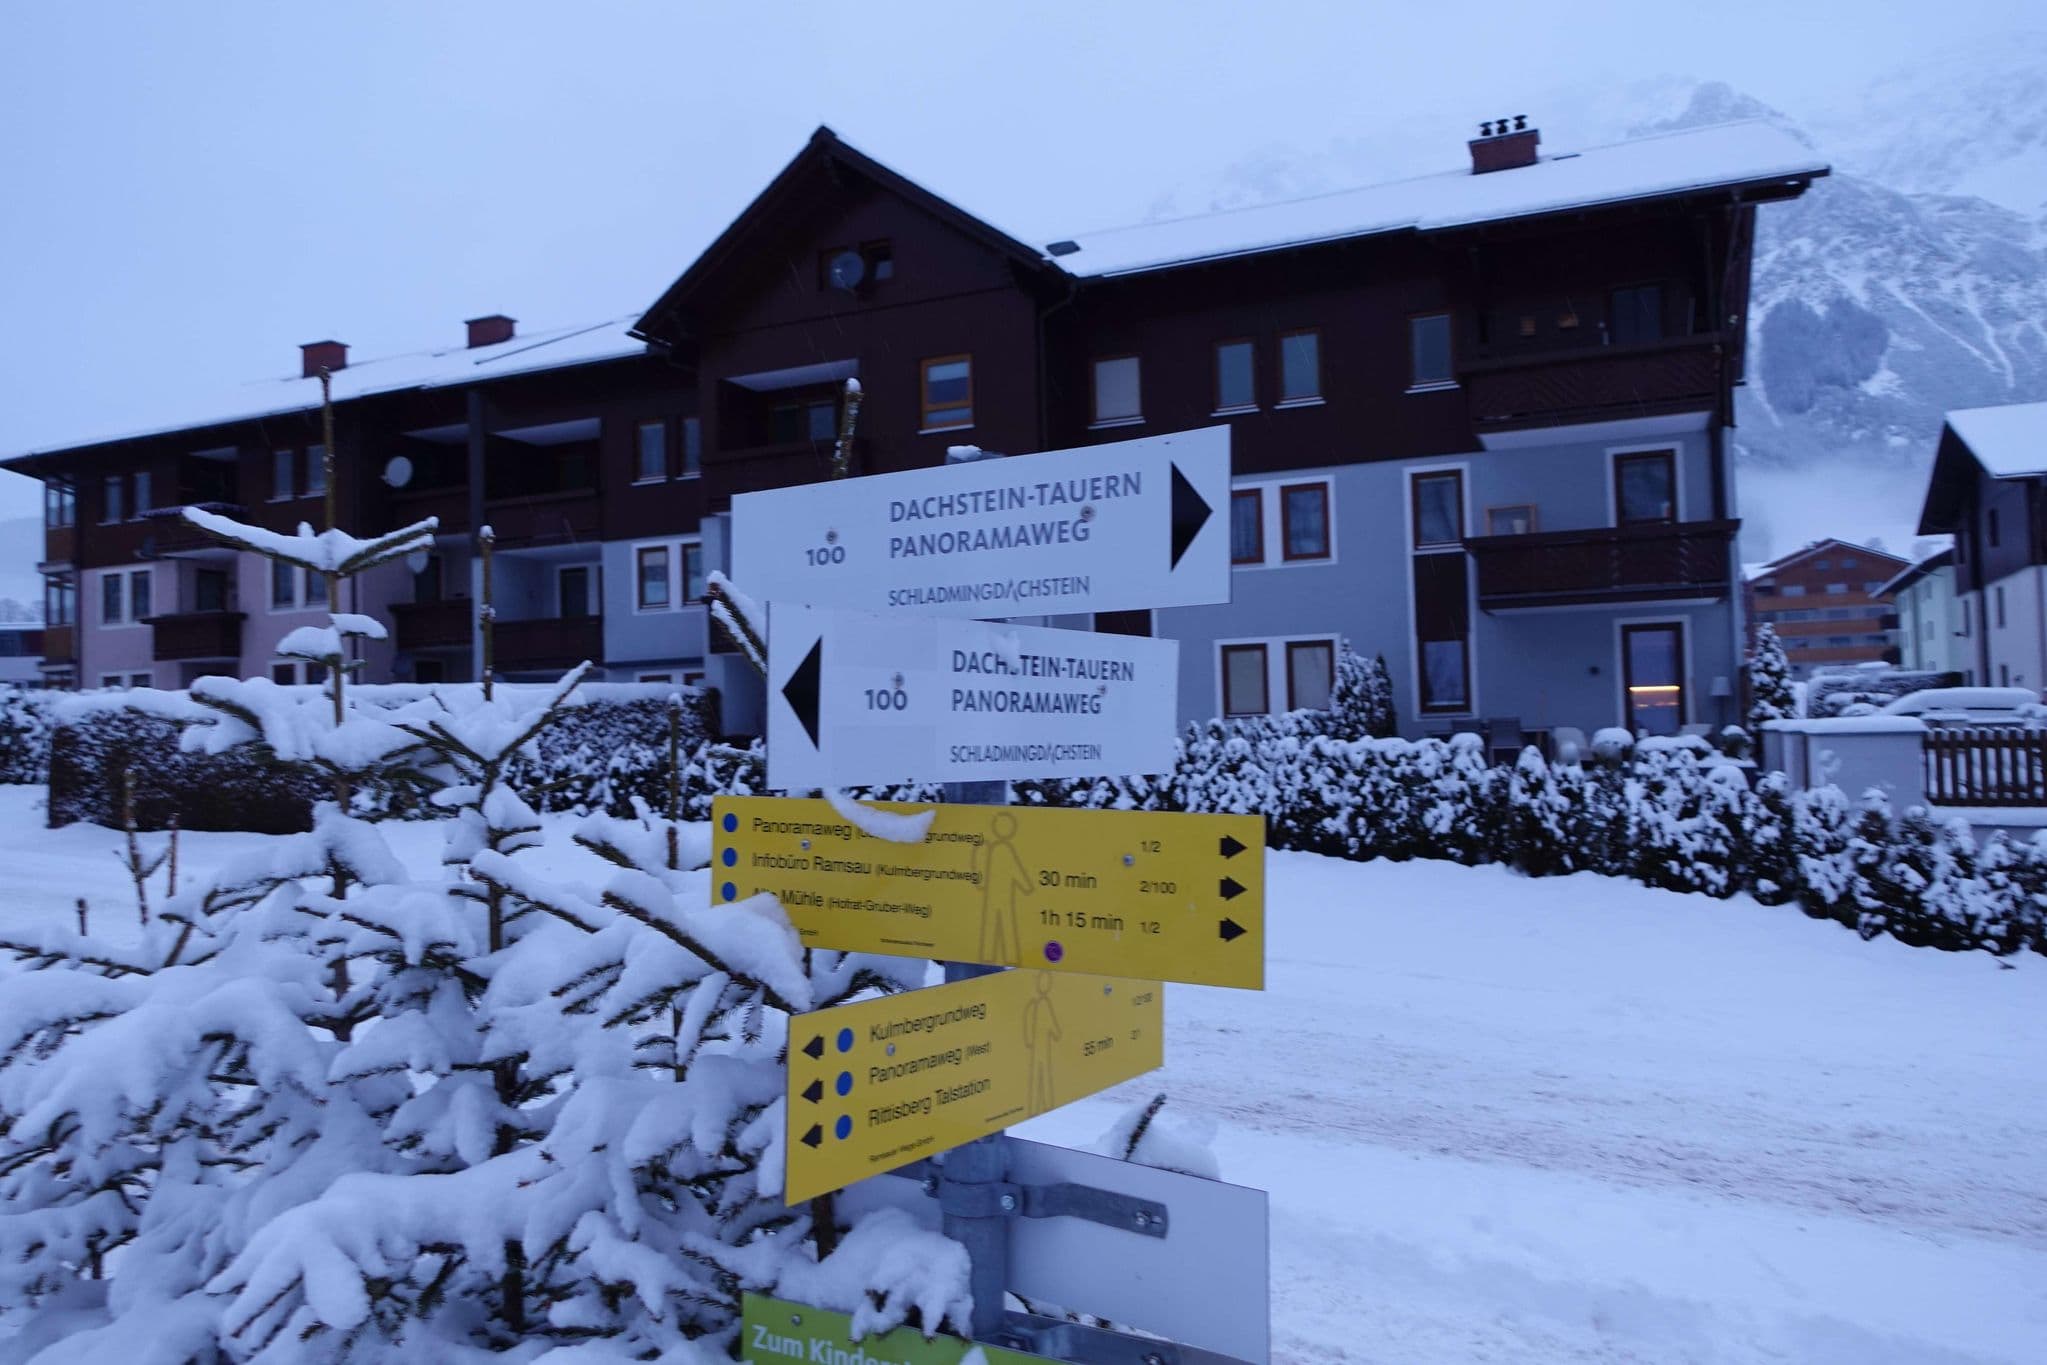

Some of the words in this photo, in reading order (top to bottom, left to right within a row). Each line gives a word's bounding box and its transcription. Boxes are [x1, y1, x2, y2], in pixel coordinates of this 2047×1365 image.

[890, 471, 1142, 523] DACHSTEIN-TAUERN
[890, 518, 1089, 558] PANORAMAWEG
[805, 546, 846, 566] 100
[952, 649, 1135, 682] DACHTEIN-TAUERN
[865, 689, 908, 711] 100
[951, 689, 1102, 714] PANORAMAWEG
[752, 817, 852, 840] Panoramaweg
[1140, 840, 1161, 853] 1/2
[752, 852, 809, 871] Infobüro
[813, 856, 871, 874] Ramsau
[876, 863, 983, 885] (Kulmbergrundweg)
[1039, 870, 1060, 887] 30
[1064, 872, 1097, 889] min
[781, 889, 825, 908] Mühle
[1139, 880, 1177, 895] 2/100
[1040, 909, 1060, 926] 1h
[1066, 911, 1087, 928] 15
[1091, 914, 1124, 931] min
[1140, 921, 1161, 934] 1/2
[870, 1002, 986, 1042] Kulmbergrundweg
[869, 1047, 962, 1085] Panoramaweg
[868, 1096, 932, 1127] Rittisberg
[935, 1078, 991, 1105] Talstation
[752, 1323, 804, 1359] Zum
